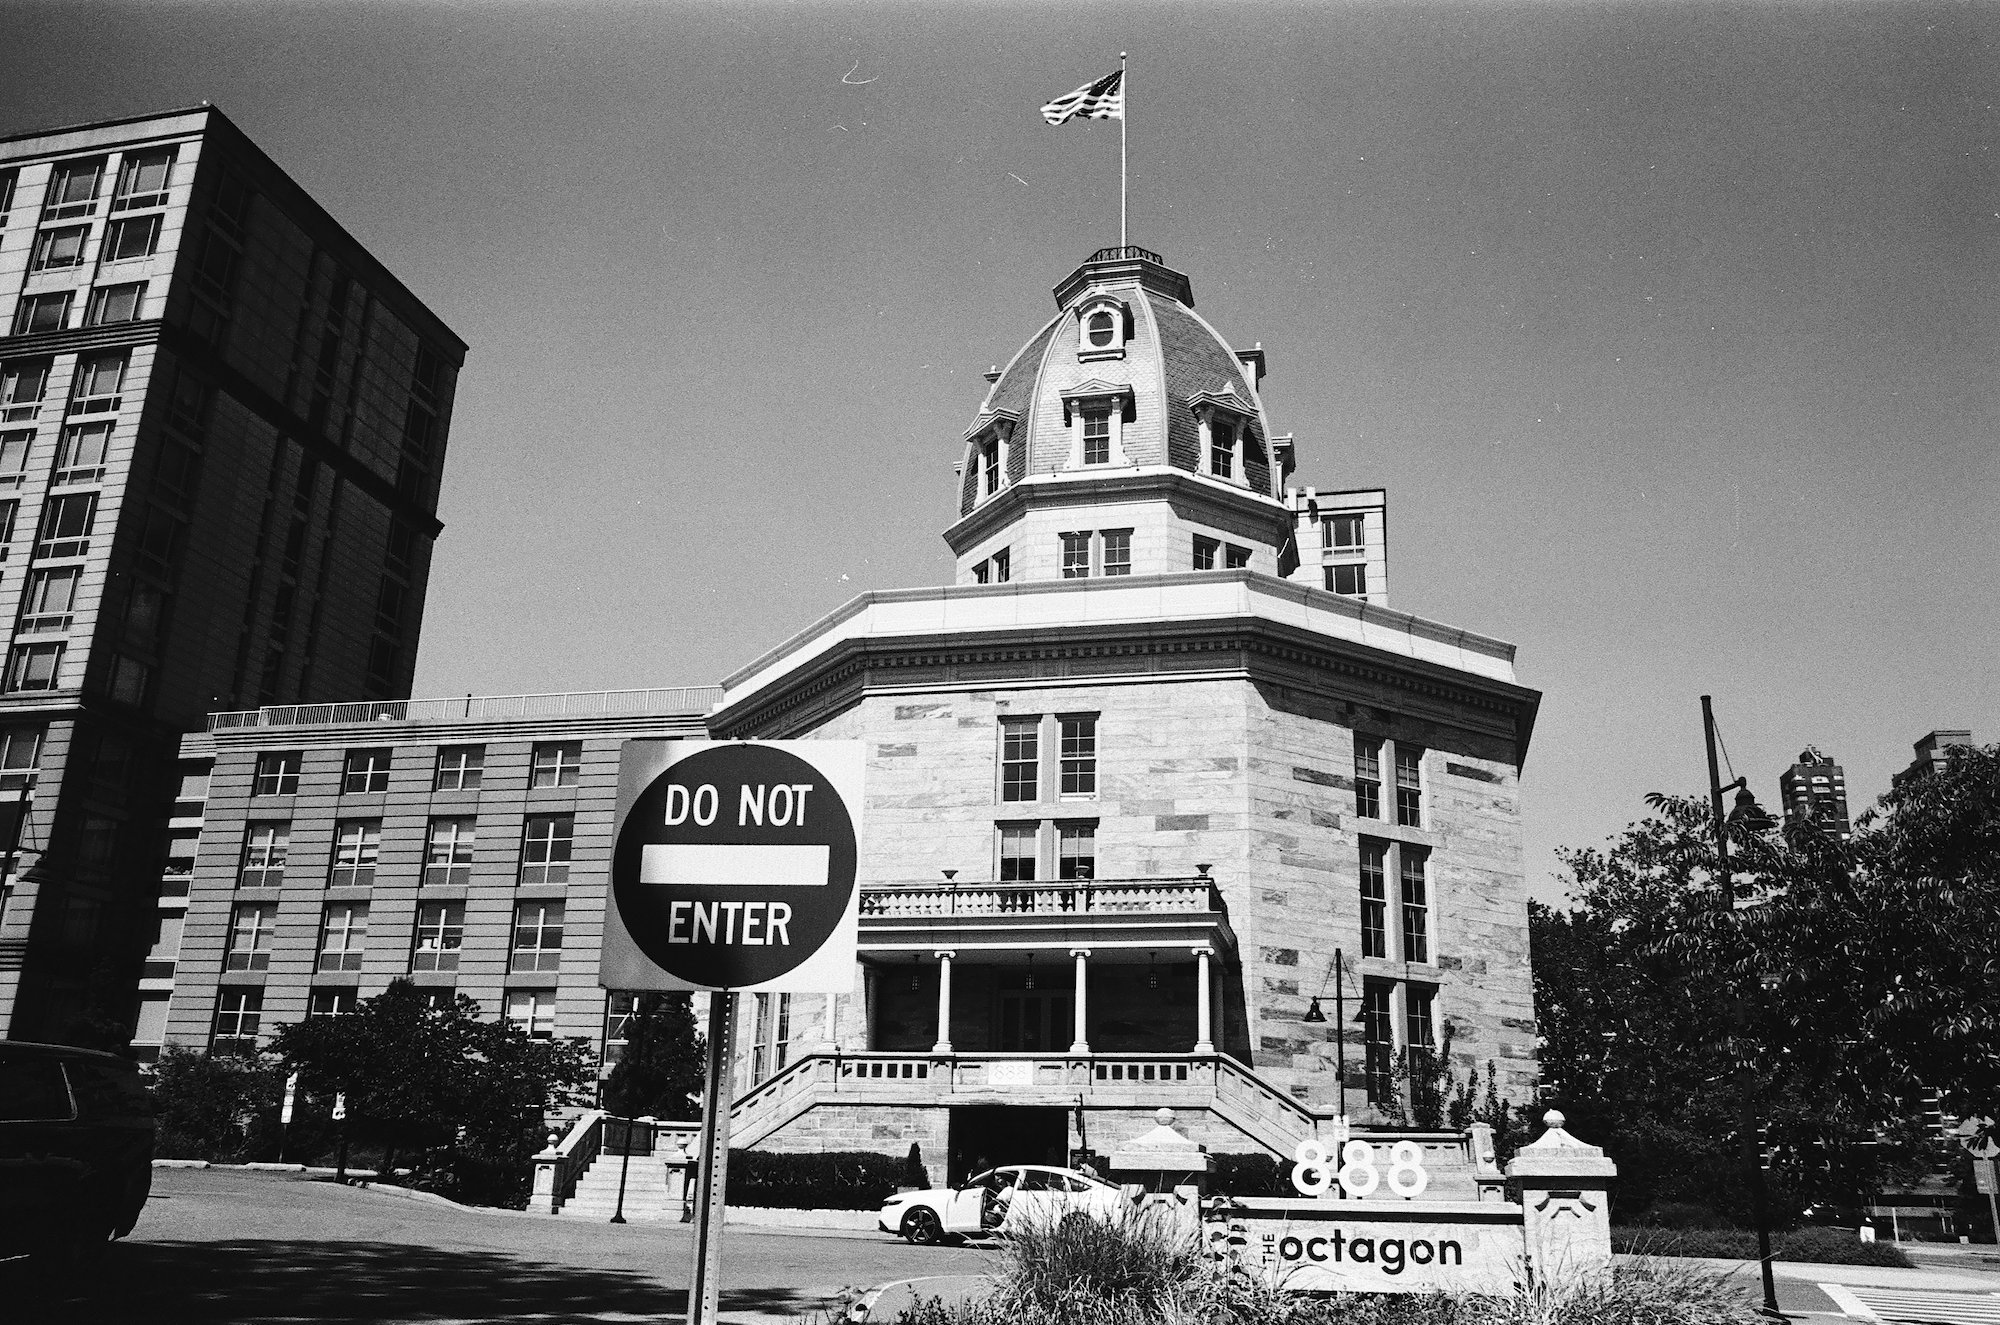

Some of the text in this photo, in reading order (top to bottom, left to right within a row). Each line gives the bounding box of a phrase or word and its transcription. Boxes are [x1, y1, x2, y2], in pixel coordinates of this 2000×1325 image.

[664, 783, 813, 826] DO NOT
[667, 901, 792, 946] ENTER
[994, 1064, 1026, 1080] 888
[1291, 1140, 1428, 1197] 888
[1262, 1233, 1275, 1265] THE
[1279, 1229, 1462, 1275] octagon
